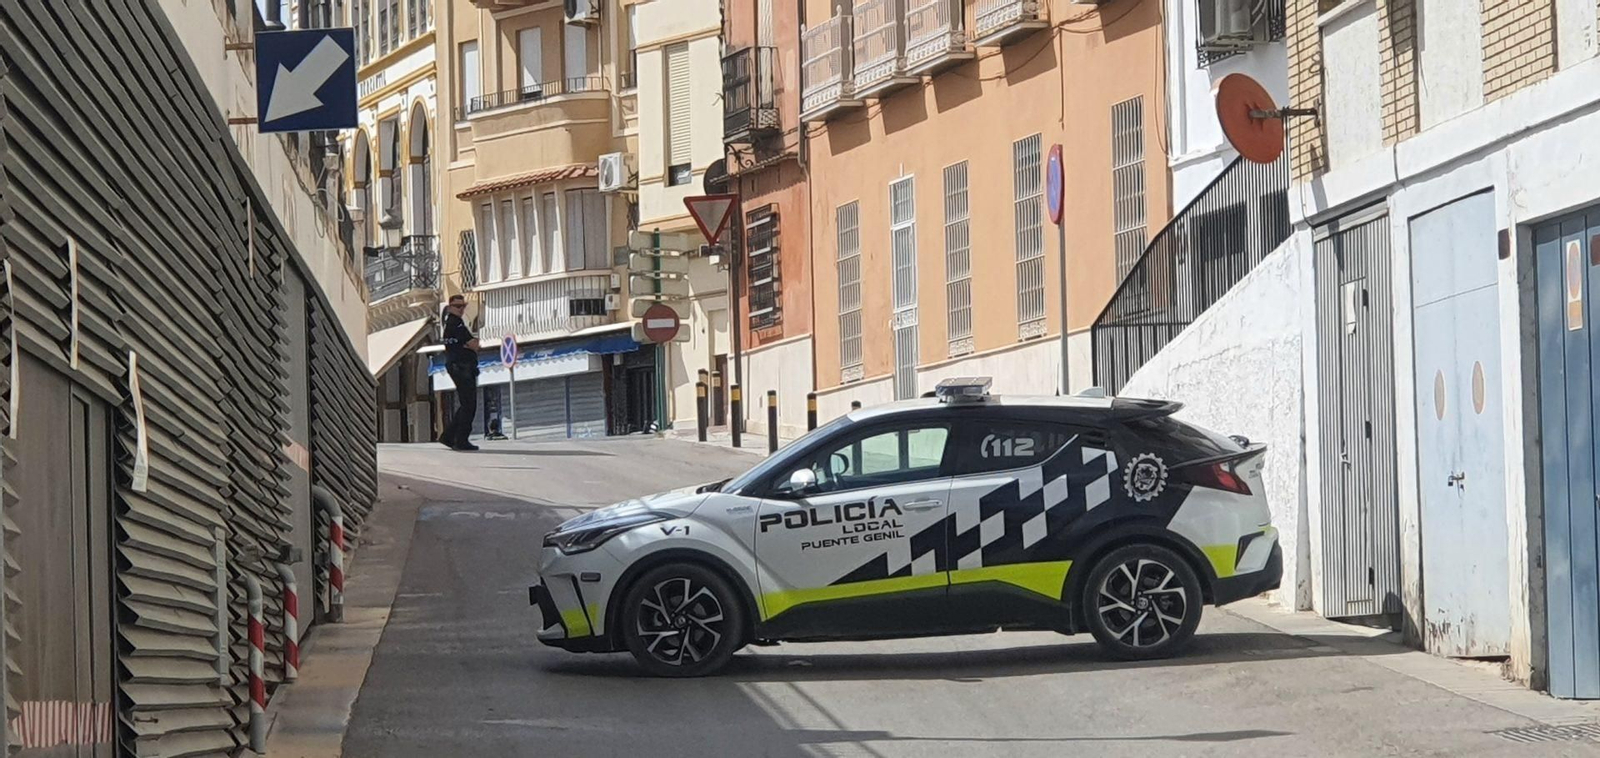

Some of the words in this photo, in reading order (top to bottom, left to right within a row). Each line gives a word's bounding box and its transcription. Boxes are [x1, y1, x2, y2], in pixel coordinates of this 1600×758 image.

[991, 438, 1034, 457] 112
[759, 496, 903, 533] POLICÍA
[660, 526, 690, 535] V-1
[842, 519, 904, 534] LOCAL
[801, 535, 860, 550] PUENTE
[864, 531, 905, 543] GENIL
